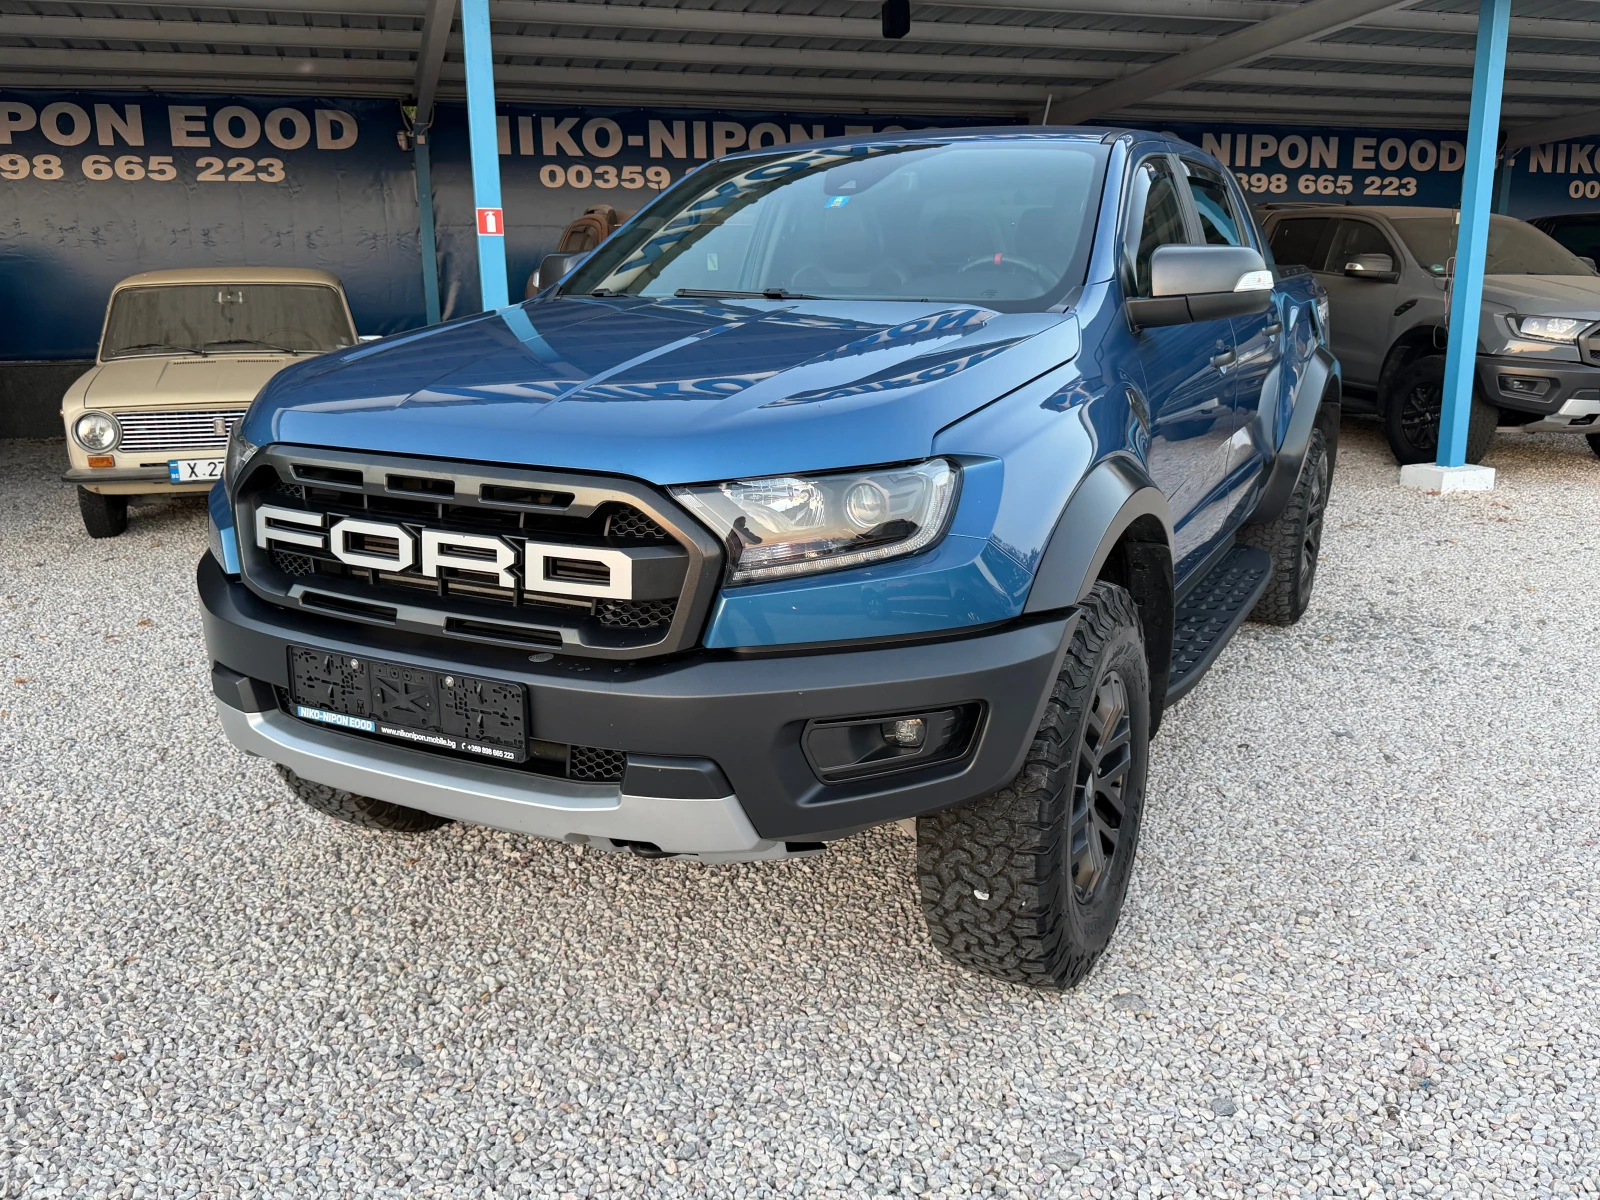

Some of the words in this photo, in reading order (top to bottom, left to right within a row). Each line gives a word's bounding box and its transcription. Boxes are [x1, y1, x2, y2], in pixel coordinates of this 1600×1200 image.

[0, 101, 145, 147] PON
[168, 105, 359, 150] EOOD
[0, 153, 65, 180] 98
[81, 154, 177, 181] 665
[196, 156, 286, 183] 223
[1352, 137, 1466, 172] EOOD
[1528, 143, 1600, 175] NIK
[539, 164, 671, 190] 00359
[1297, 174, 1354, 195] 665
[1363, 176, 1418, 197] 223
[187, 462, 199, 479] X
[255, 504, 633, 600] FORD
[349, 717, 373, 731] EOOD
[381, 726, 457, 749] www.nikonipon.mobile.bg
[503, 751, 515, 760] 223
